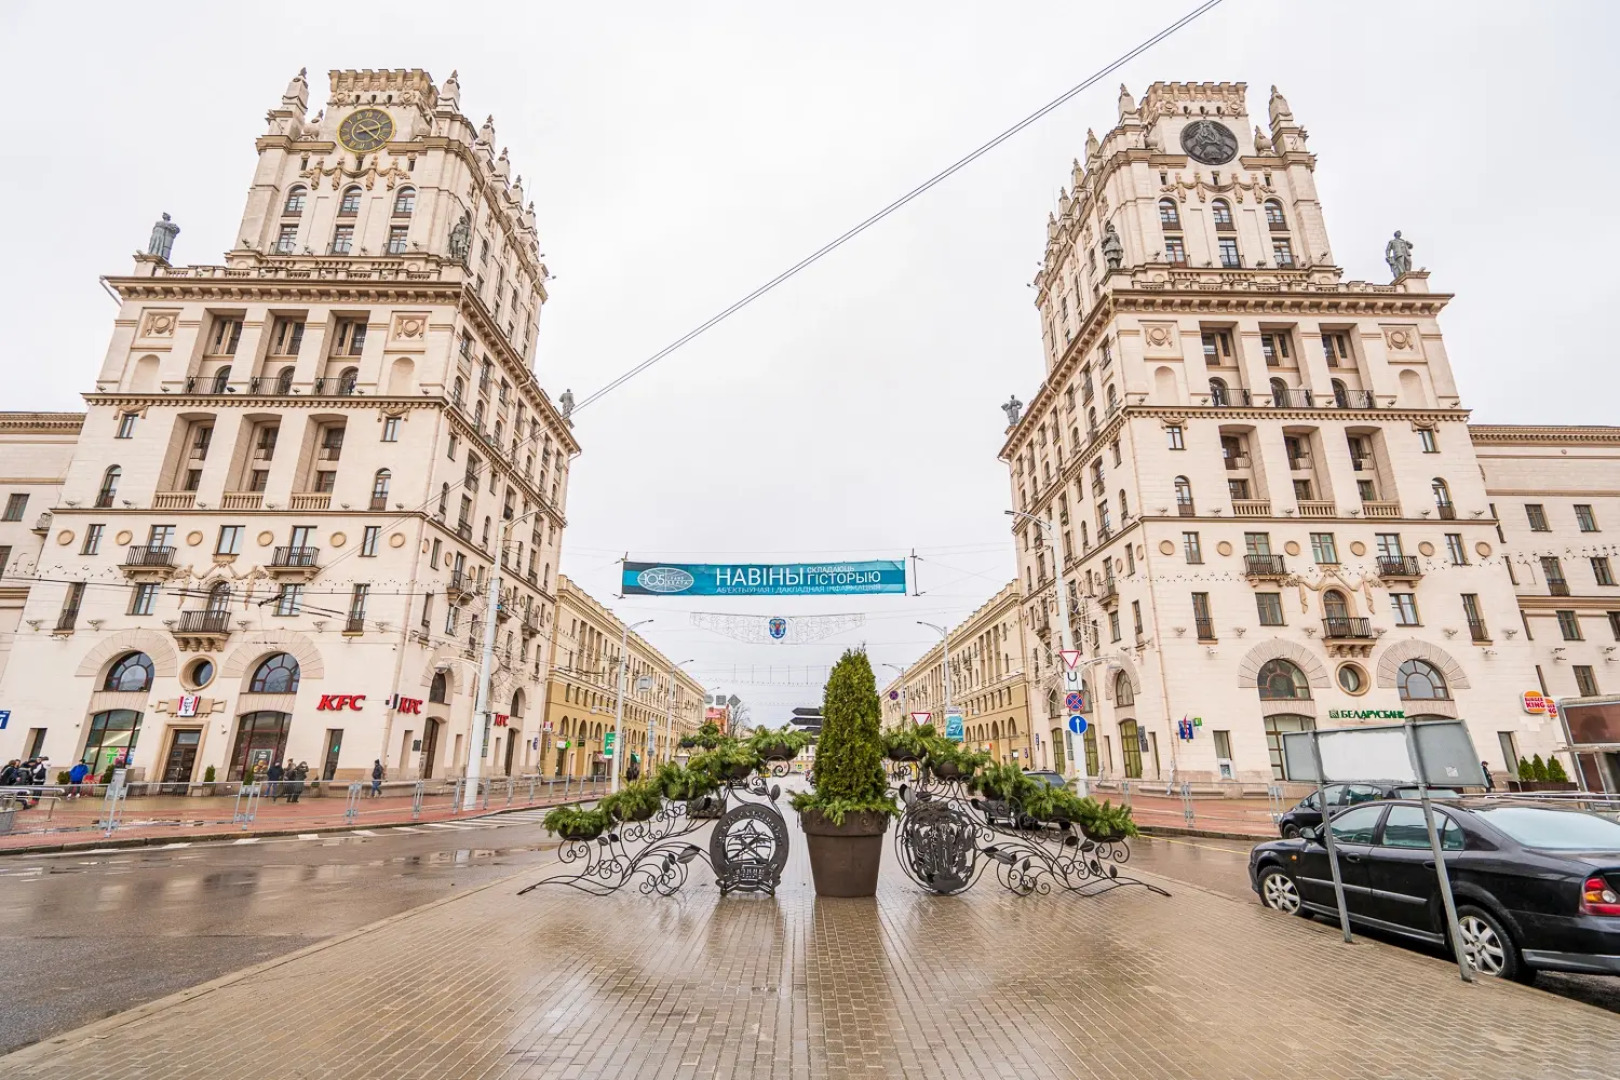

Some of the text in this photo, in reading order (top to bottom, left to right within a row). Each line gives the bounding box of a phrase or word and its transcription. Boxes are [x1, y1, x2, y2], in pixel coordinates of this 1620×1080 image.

[807, 565, 855, 574] СКЛАДАЮЦЬ
[644, 573, 665, 585] 105
[716, 567, 804, 586] НАВІНЫ
[807, 571, 881, 585] ГІСТОРЫЮ
[316, 694, 366, 712] KFC
[397, 697, 423, 715] KFC
[1525, 701, 1546, 709] KING
[1340, 710, 1405, 719] БЕЛАРУСБАНК
